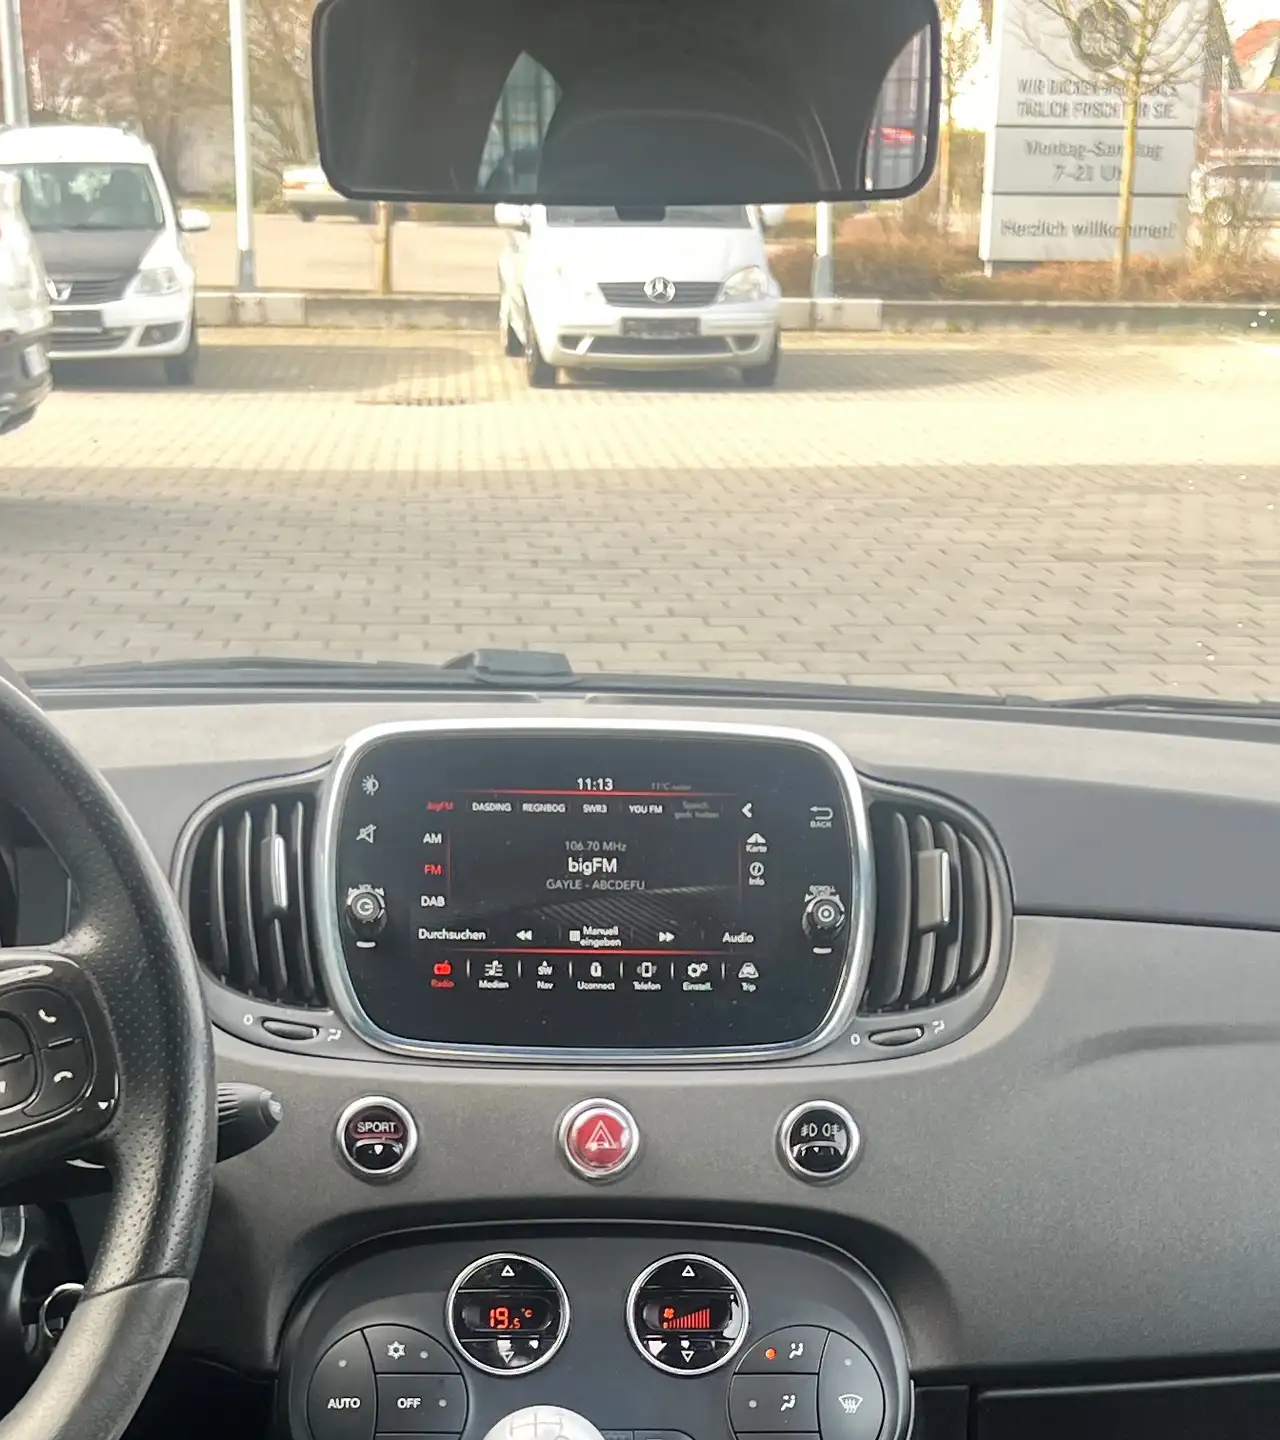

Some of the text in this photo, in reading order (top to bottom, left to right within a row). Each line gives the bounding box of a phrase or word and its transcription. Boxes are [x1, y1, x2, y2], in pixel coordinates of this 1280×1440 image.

[577, 778, 613, 791] 11:13
[472, 802, 512, 812] DASDING
[583, 804, 608, 813] SWR3
[629, 804, 648, 814] YOU
[649, 804, 663, 814] FM
[423, 833, 442, 844] AM
[603, 841, 627, 852] MHz
[424, 864, 442, 875] FM
[568, 856, 618, 875] bigFM
[546, 879, 582, 890] GAYLE
[591, 880, 645, 891] ABCDEFU
[420, 896, 445, 907] DAB
[418, 925, 755, 943] Durchsuchen Manuell Audio
[579, 937, 622, 947] eingeben
[479, 979, 510, 990] Medien
[537, 980, 554, 990] Nav
[577, 981, 616, 991] Uconnect
[633, 981, 662, 991] Telefon
[357, 1120, 397, 1134] SPORT
[327, 1397, 361, 1410] AUTO
[397, 1397, 422, 1410] OFF
